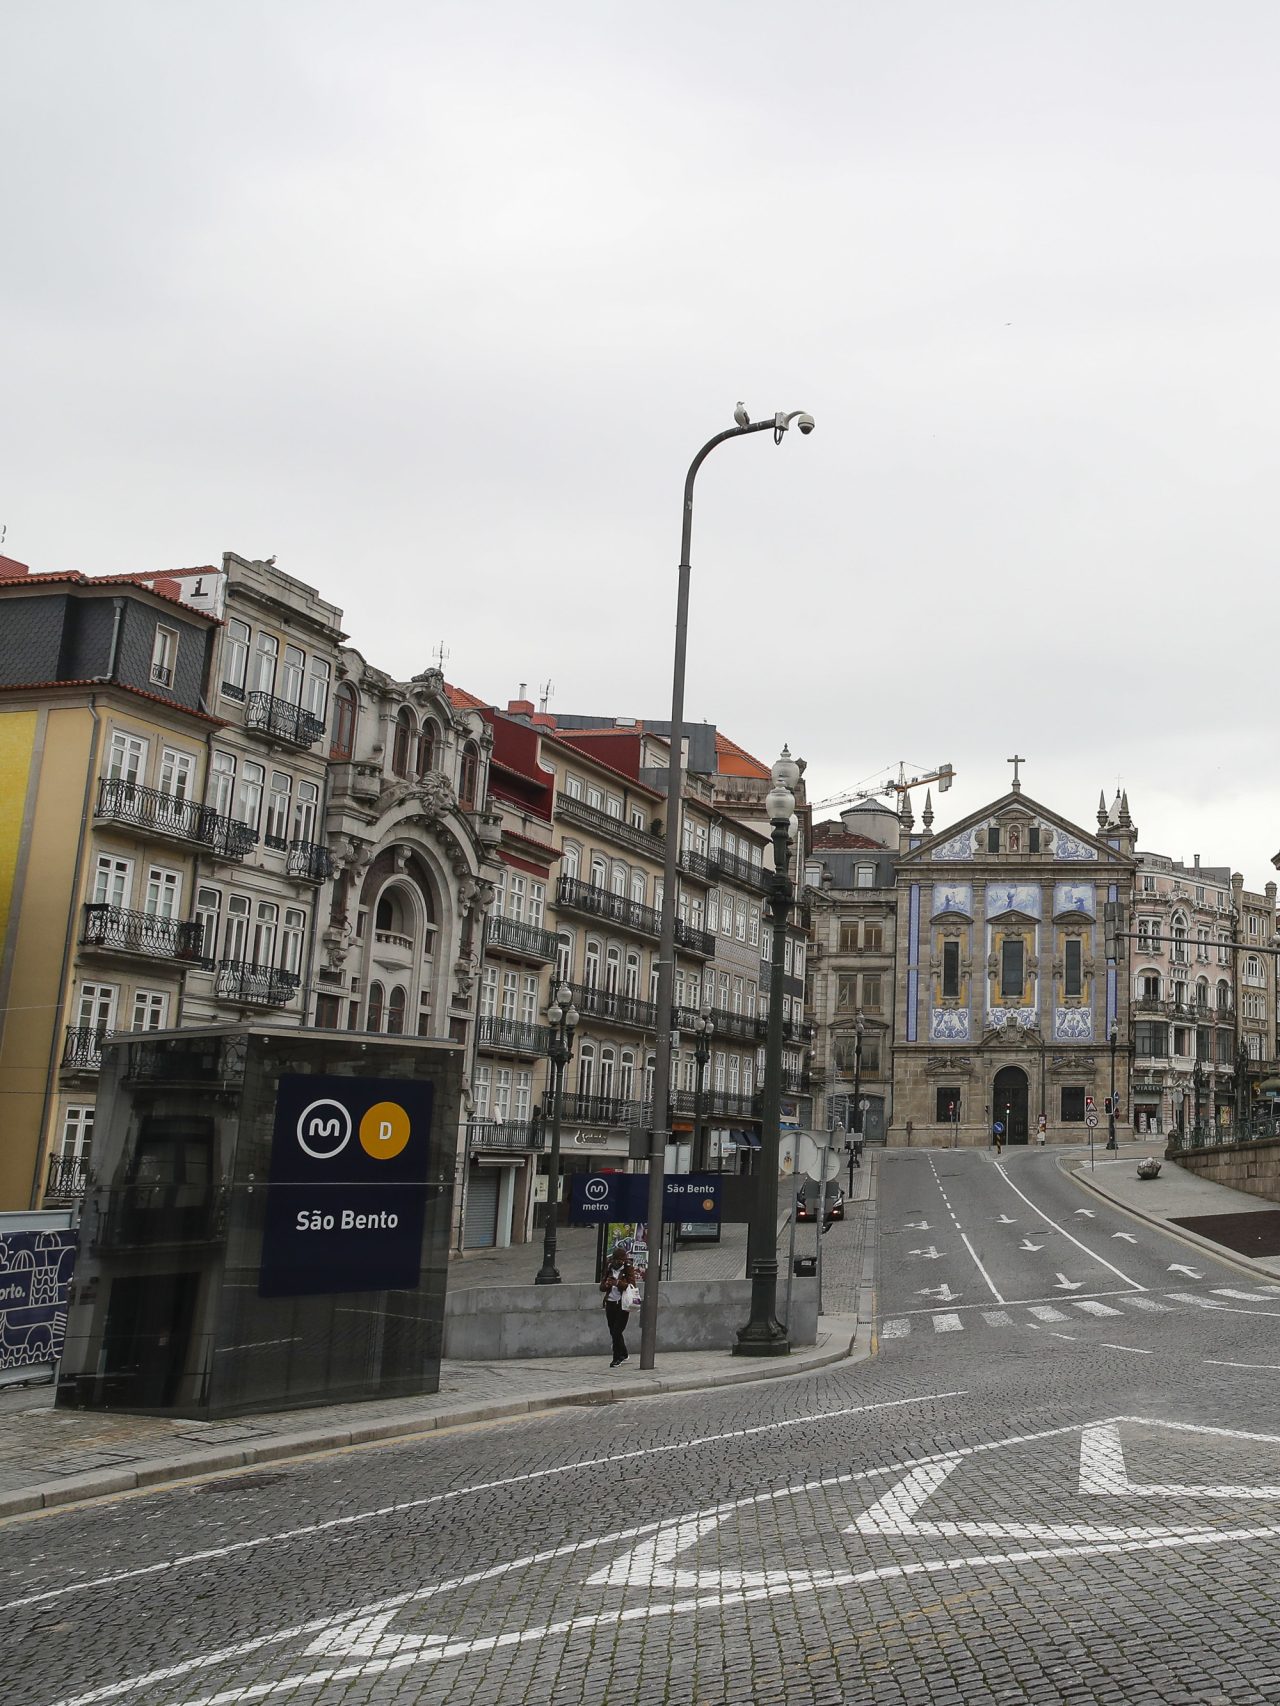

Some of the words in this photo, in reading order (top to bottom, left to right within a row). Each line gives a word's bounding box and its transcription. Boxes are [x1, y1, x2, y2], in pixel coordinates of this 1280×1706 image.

[379, 1121, 392, 1140] D
[667, 1183, 685, 1193] São
[687, 1184, 715, 1193] Bento
[583, 1203, 609, 1211] metro
[296, 1210, 335, 1231] São
[341, 1210, 399, 1230] Bento
